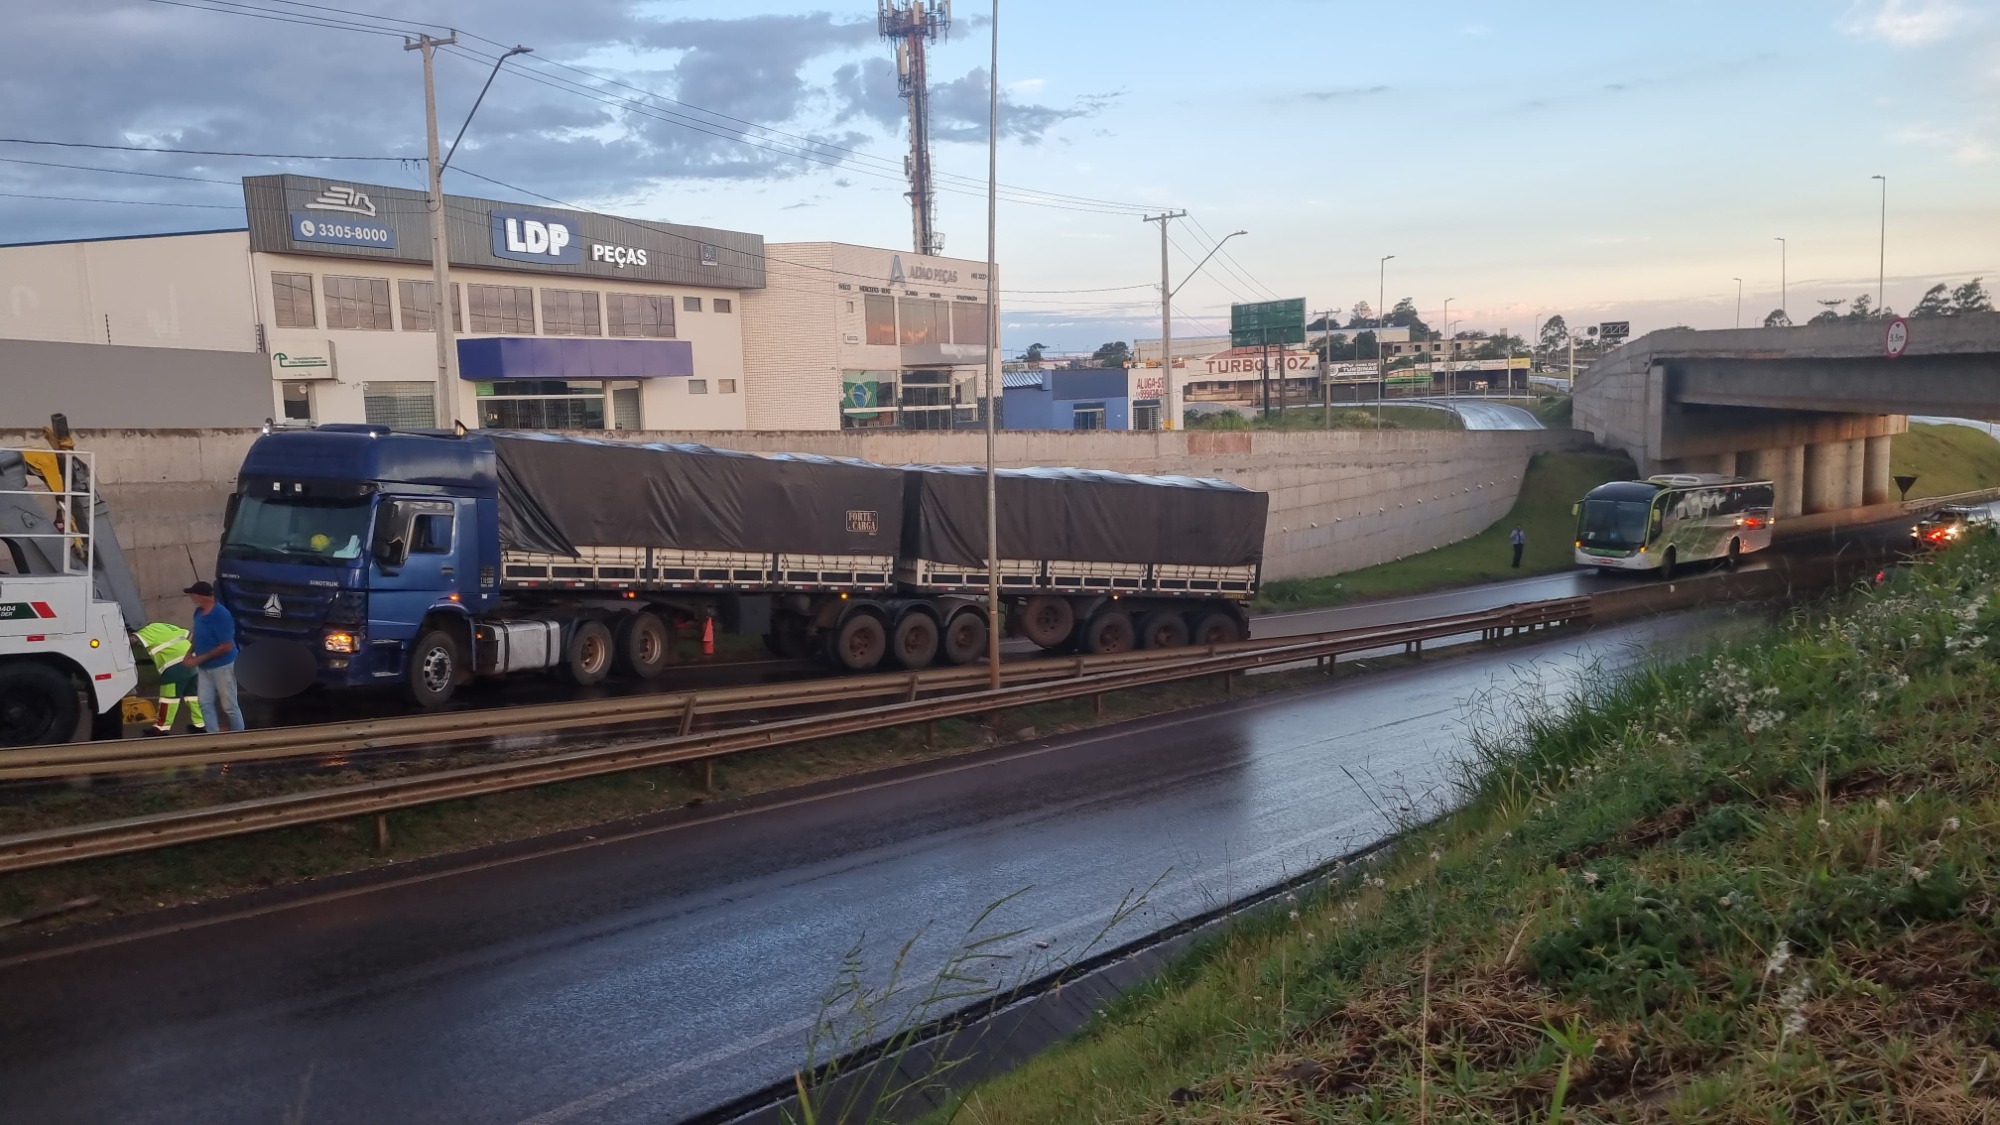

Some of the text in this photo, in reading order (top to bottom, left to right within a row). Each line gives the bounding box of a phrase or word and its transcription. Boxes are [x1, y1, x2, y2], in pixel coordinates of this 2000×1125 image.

[318, 223, 388, 242] 3305-8000
[505, 217, 648, 268] LDP PEÇAS
[934, 268, 958, 284] PEÇAS
[838, 283, 852, 291] IVECO
[1205, 359, 1265, 374] TURBO
[848, 512, 872, 522] FORTE
[852, 521, 876, 531] CARGA
